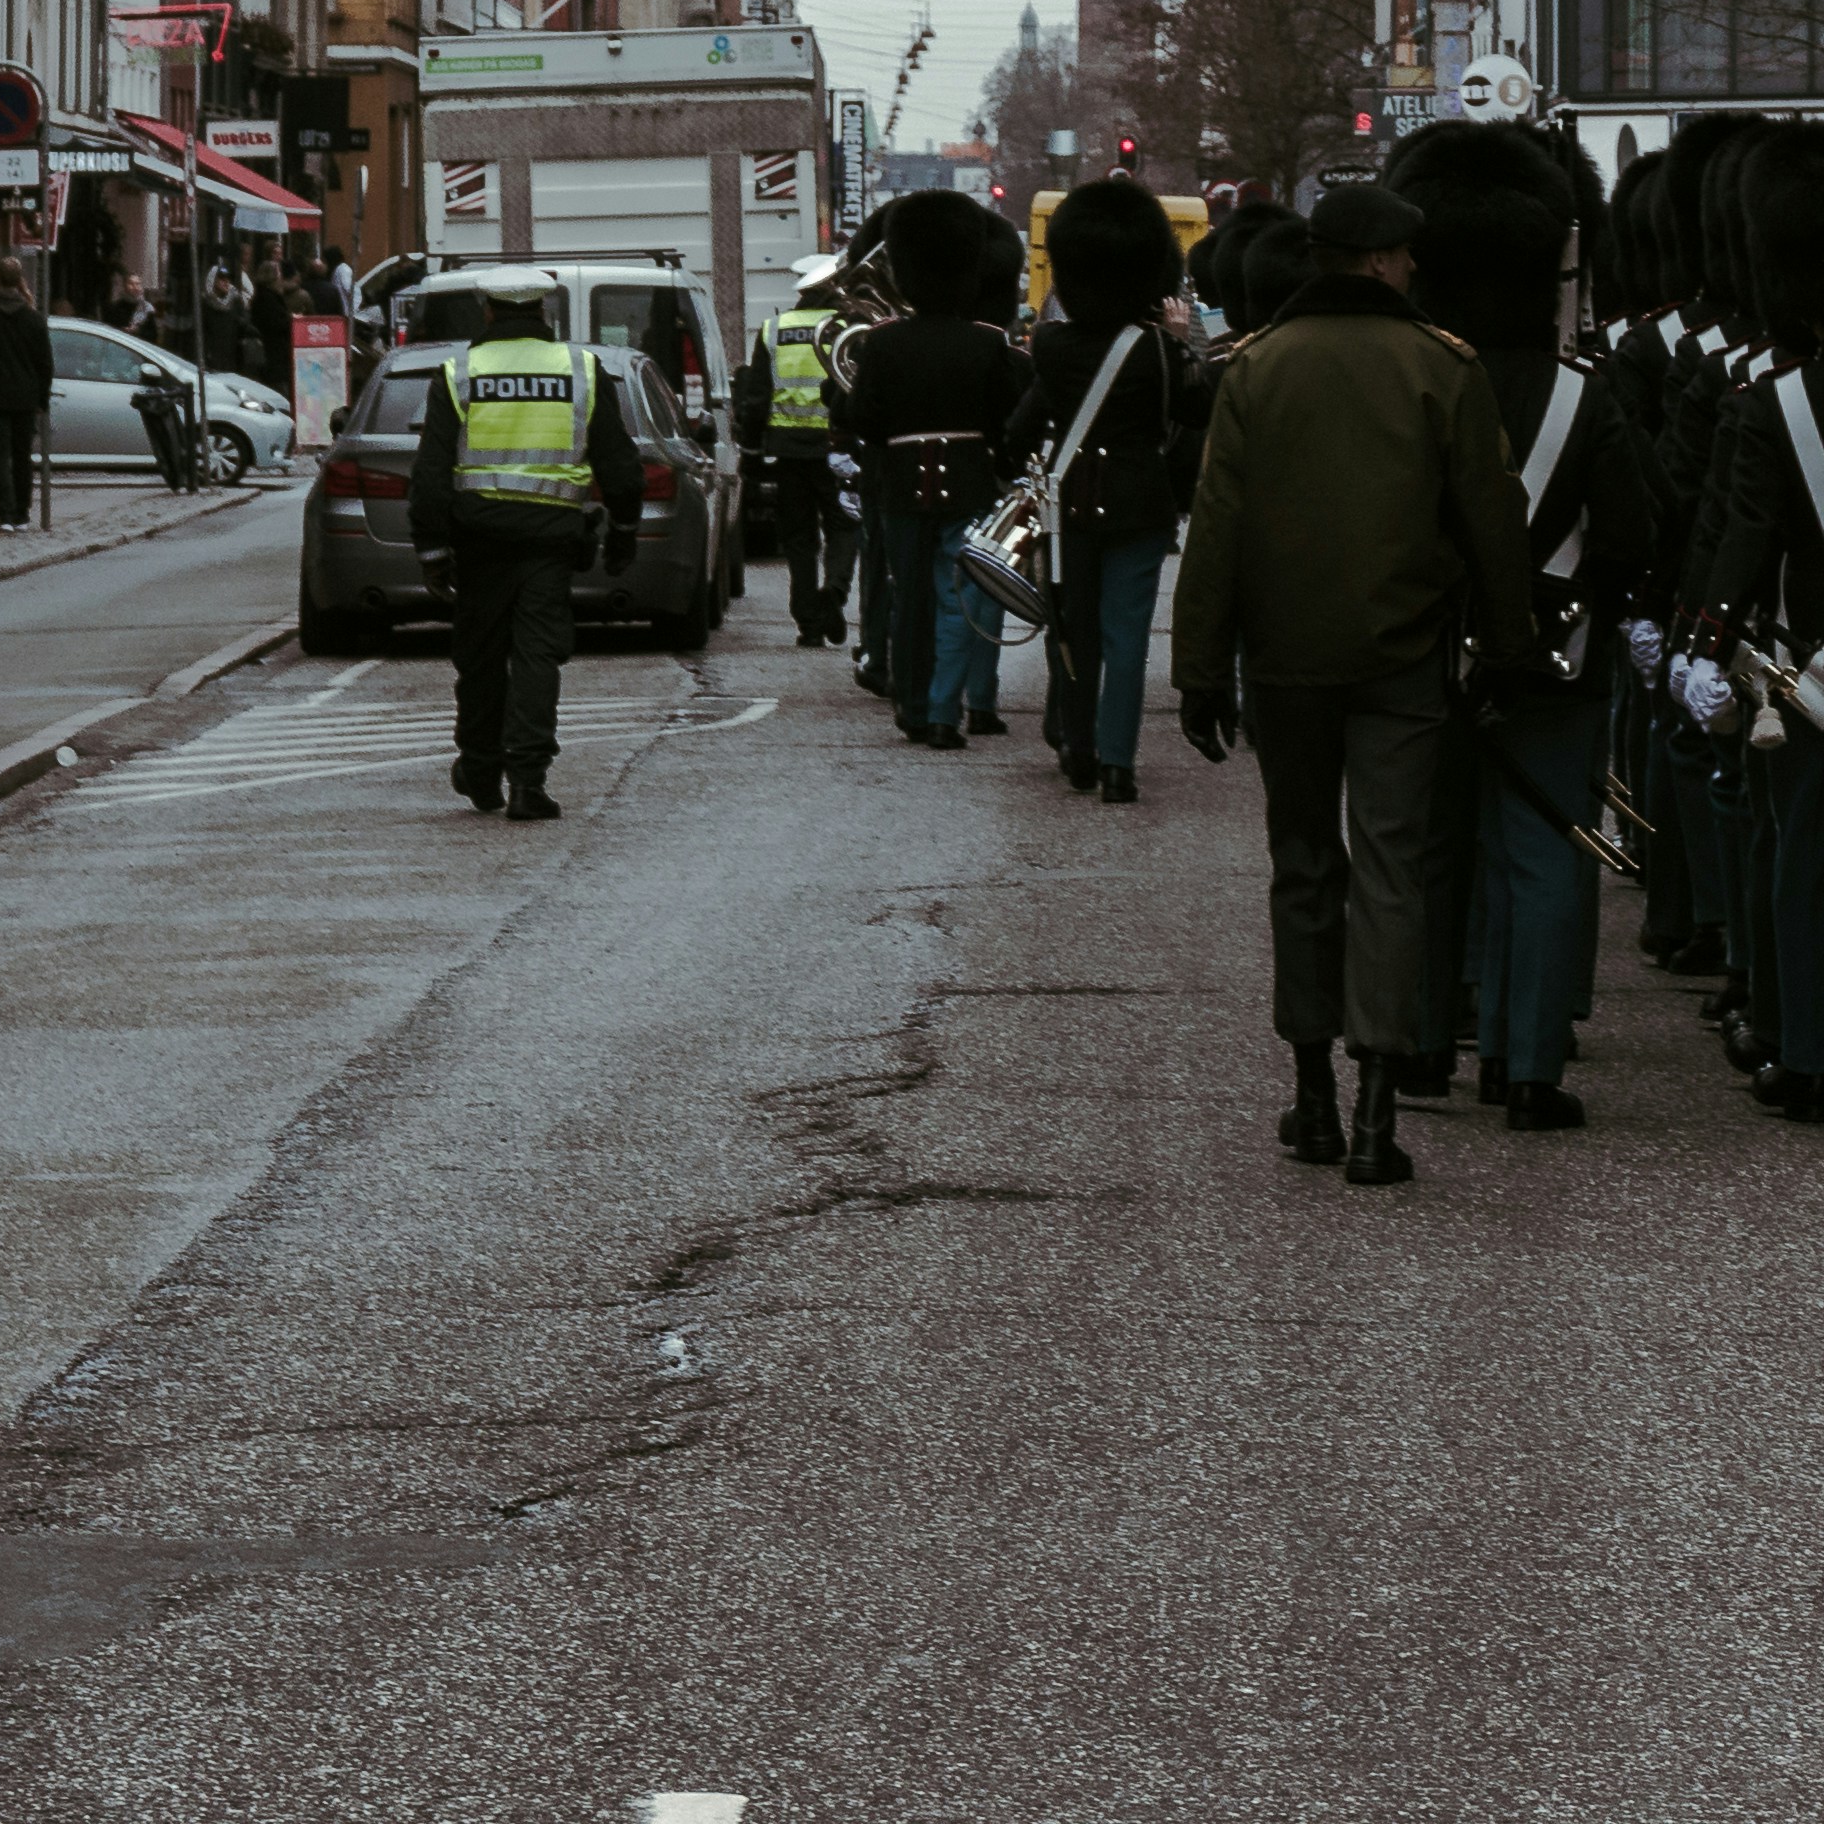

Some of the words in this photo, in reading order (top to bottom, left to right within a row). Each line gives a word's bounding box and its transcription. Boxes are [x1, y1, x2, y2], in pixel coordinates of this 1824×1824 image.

[212, 130, 274, 147] BURGERS
[47, 150, 130, 173] UPERKIOSK
[842, 103, 864, 227] CINEMATEKET
[476, 377, 566, 398] POLITI
